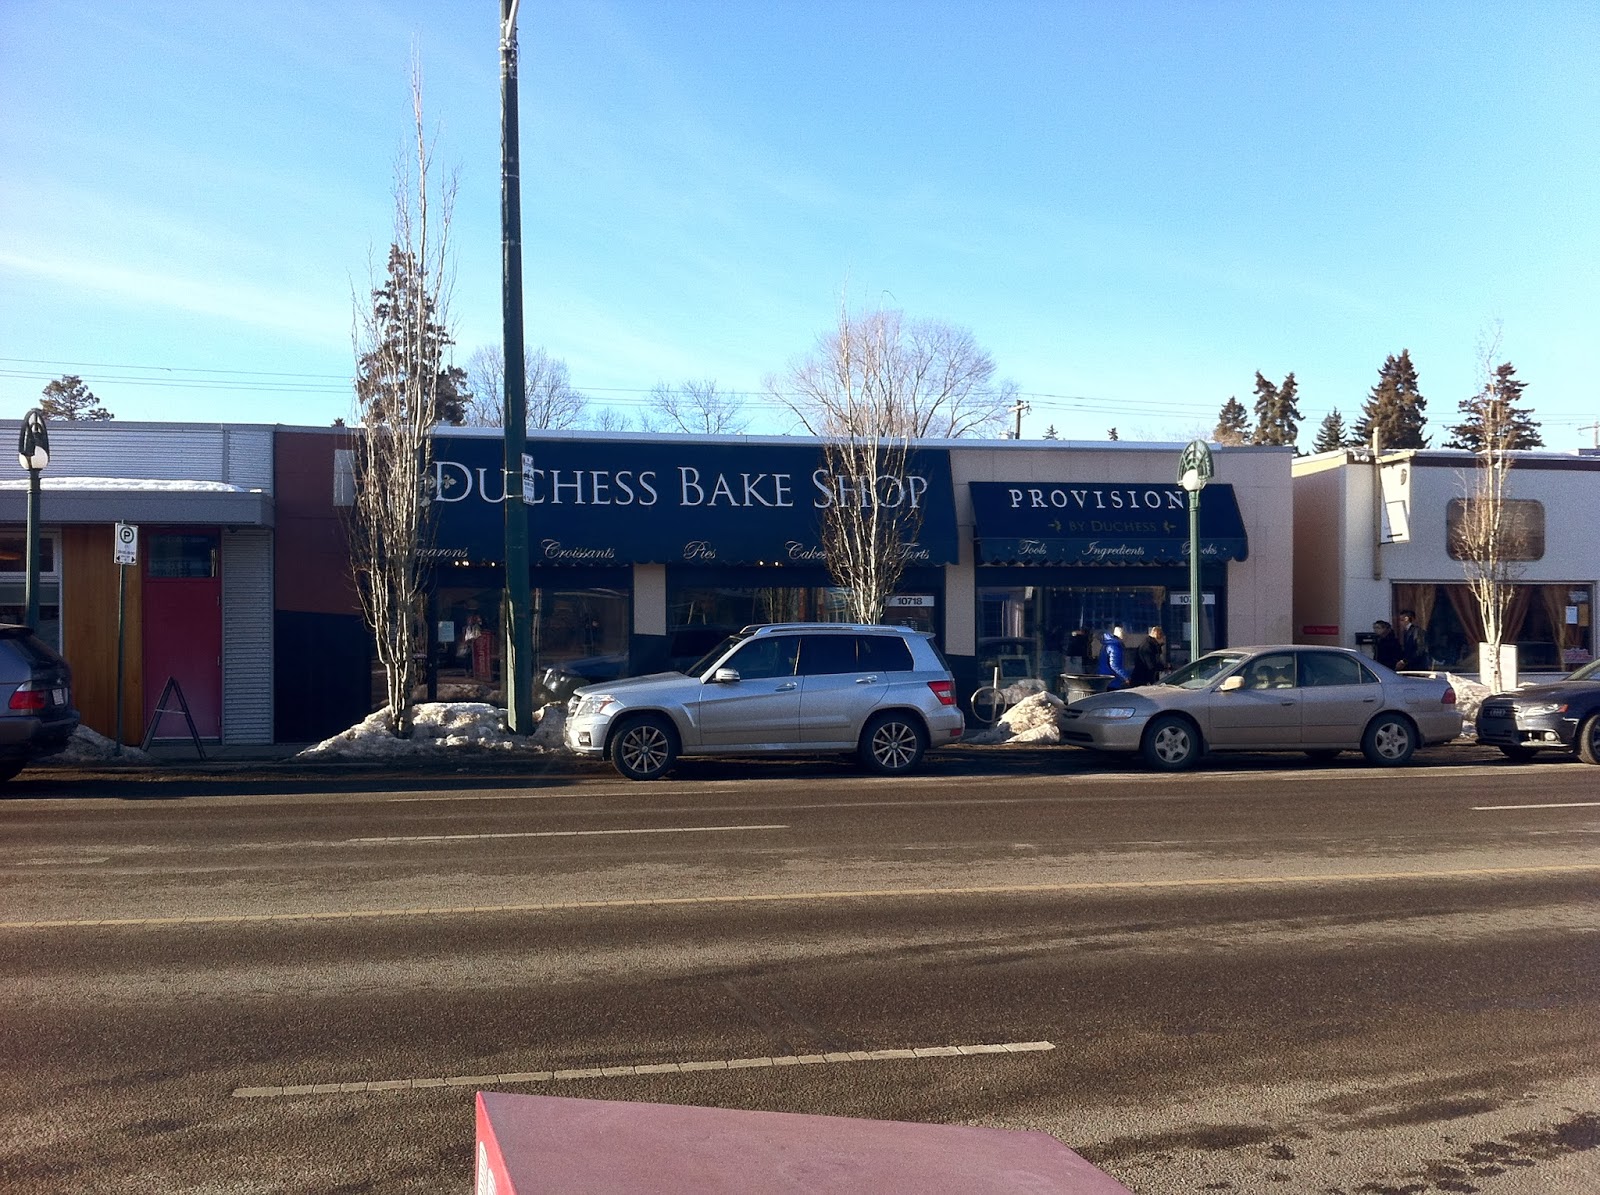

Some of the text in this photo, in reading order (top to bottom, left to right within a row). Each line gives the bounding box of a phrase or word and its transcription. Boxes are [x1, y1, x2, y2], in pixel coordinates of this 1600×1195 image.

[677, 466, 794, 508] BAKE
[812, 469, 928, 509] SHOP
[1008, 489, 1201, 509] PROVISION
[1069, 520, 1157, 532] BY DUCHESS
[411, 538, 931, 560] aarons Croissants Pies Cakes Tarts
[1017, 539, 1218, 560] Tools Ingredients oks
[897, 597, 923, 606] 10718
[1179, 595, 1206, 604] 100
